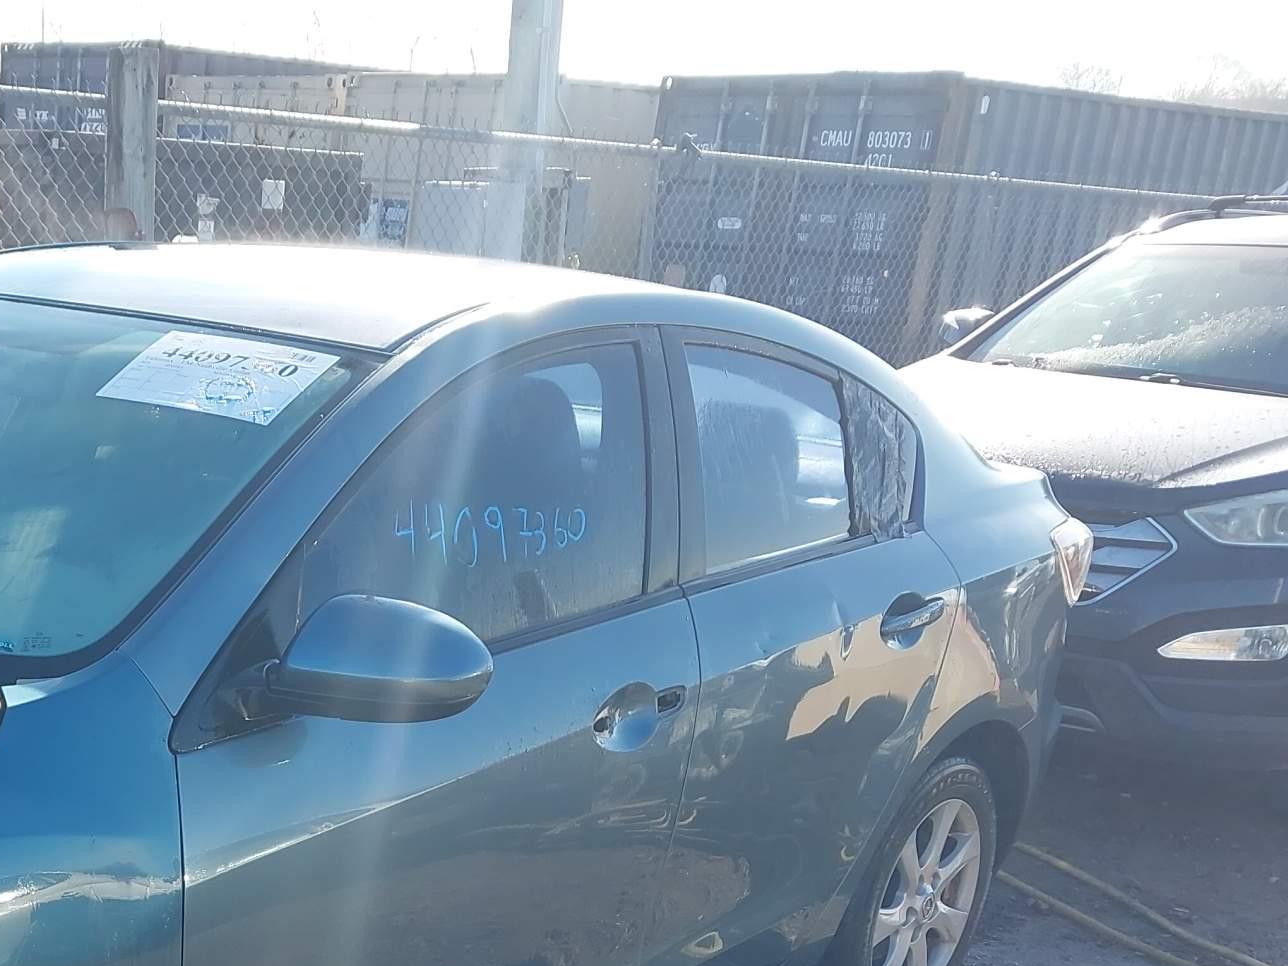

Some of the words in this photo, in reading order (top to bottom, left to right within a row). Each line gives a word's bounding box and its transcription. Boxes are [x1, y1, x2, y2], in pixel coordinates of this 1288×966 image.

[820, 130, 852, 146] CMAU
[867, 131, 912, 148] 803073
[162, 346, 299, 378] 440970
[394, 500, 586, 568] 44097360
